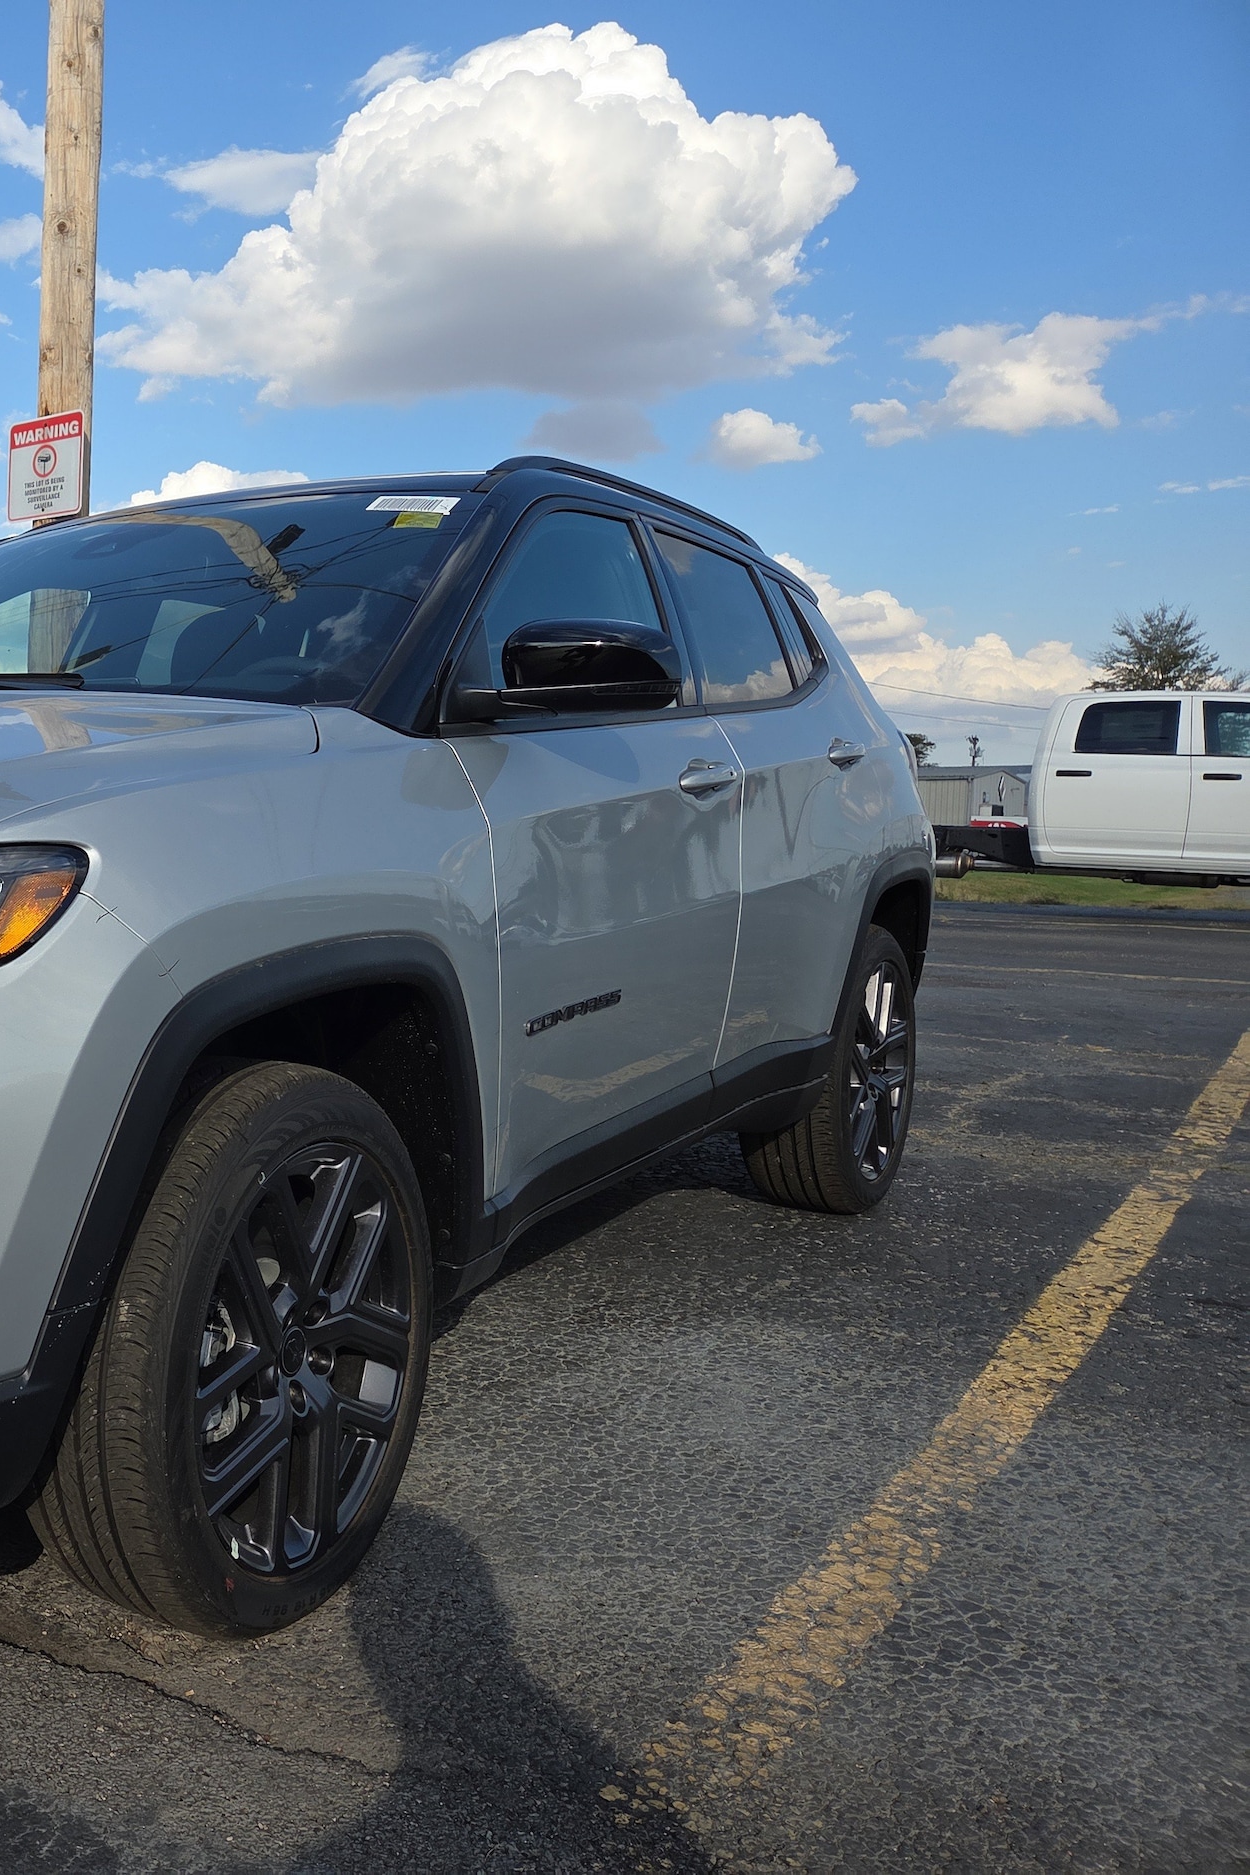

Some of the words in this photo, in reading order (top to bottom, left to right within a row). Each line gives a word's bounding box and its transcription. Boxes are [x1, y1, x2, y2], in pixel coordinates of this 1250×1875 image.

[14, 420, 79, 446] WARNING
[24, 481, 35, 489] THIS
[36, 479, 44, 487] LOT
[45, 478, 50, 486] IS
[51, 476, 65, 485] BEING
[24, 486, 52, 497] MONITORED
[27, 492, 61, 504] SURVEILLANCE
[33, 501, 53, 510] CAMERA
[525, 989, 622, 1037] COMPASS
